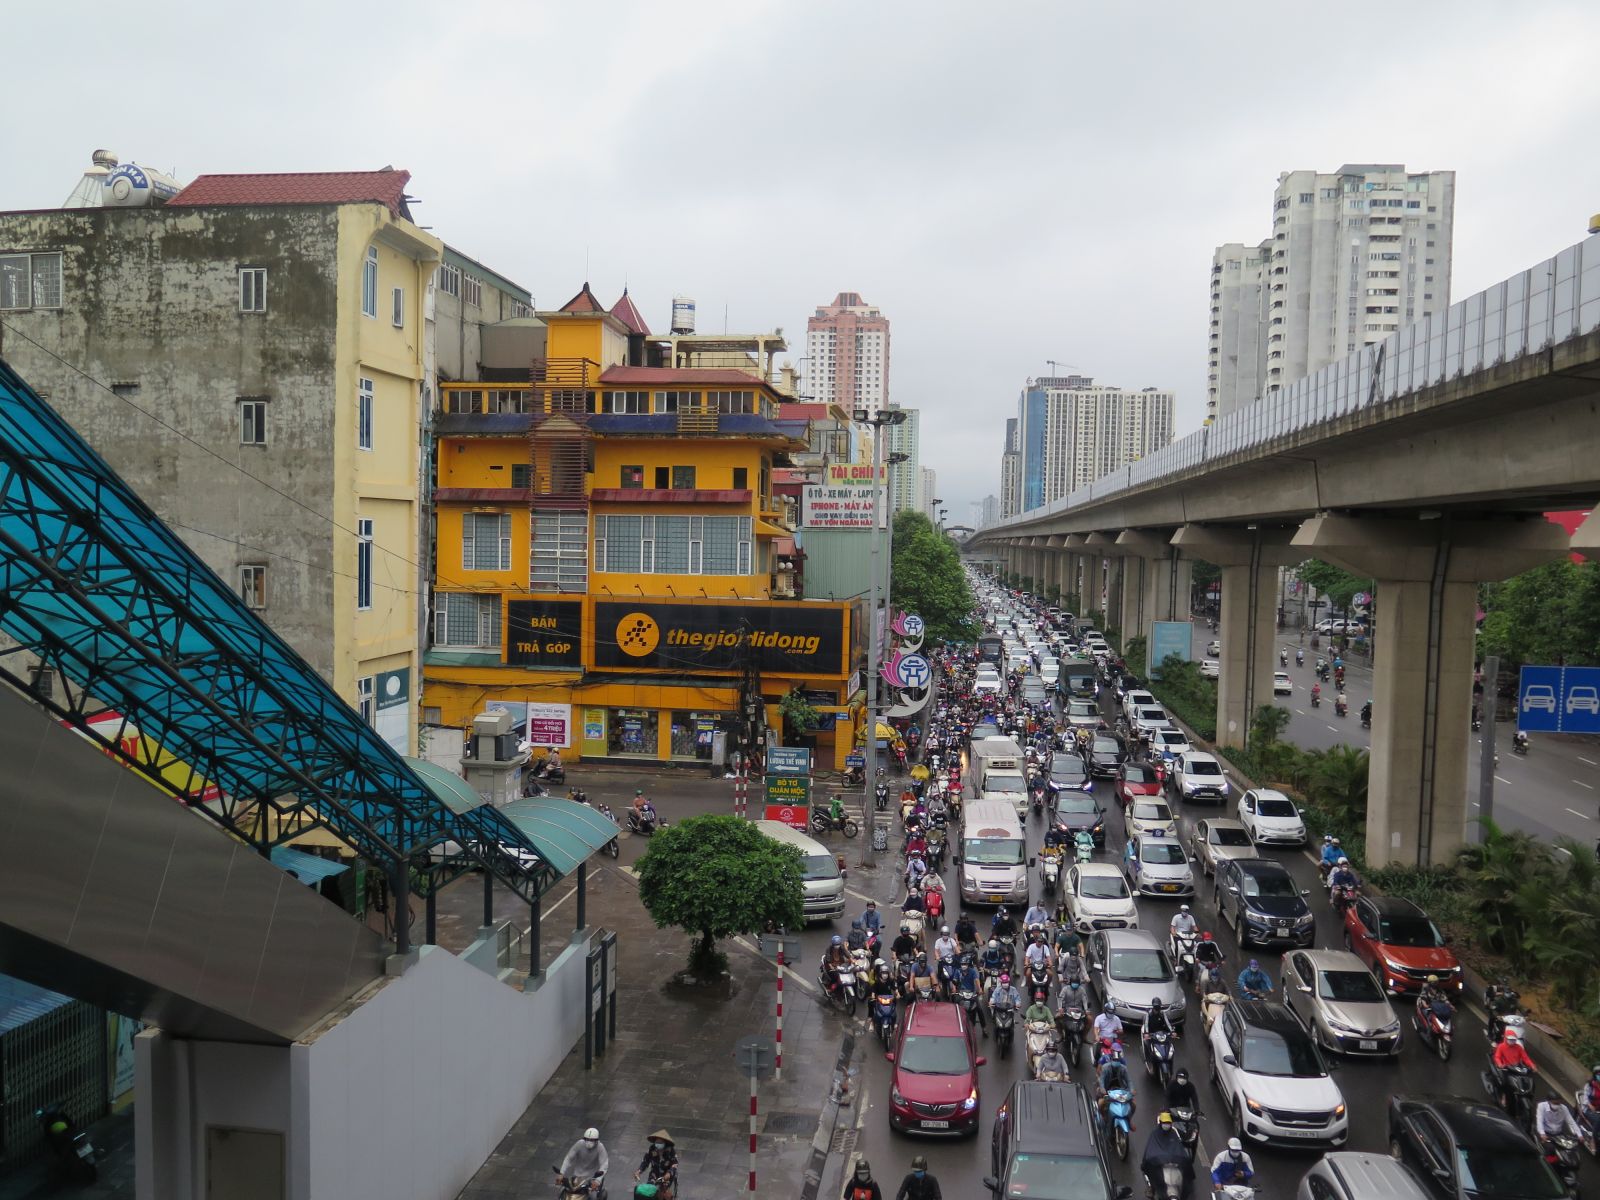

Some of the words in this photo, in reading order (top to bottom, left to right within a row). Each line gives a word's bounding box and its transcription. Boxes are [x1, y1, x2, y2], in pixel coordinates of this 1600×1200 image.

[852, 465, 884, 478] CHÍH
[828, 490, 837, 498] XE
[838, 488, 852, 498] MÁY
[858, 490, 882, 498] LAPTP
[811, 502, 839, 510] IPHONE
[844, 500, 860, 510] MÁY
[531, 615, 557, 628] BÁN
[517, 640, 540, 653] TRẢ
[546, 641, 571, 653] GÓP
